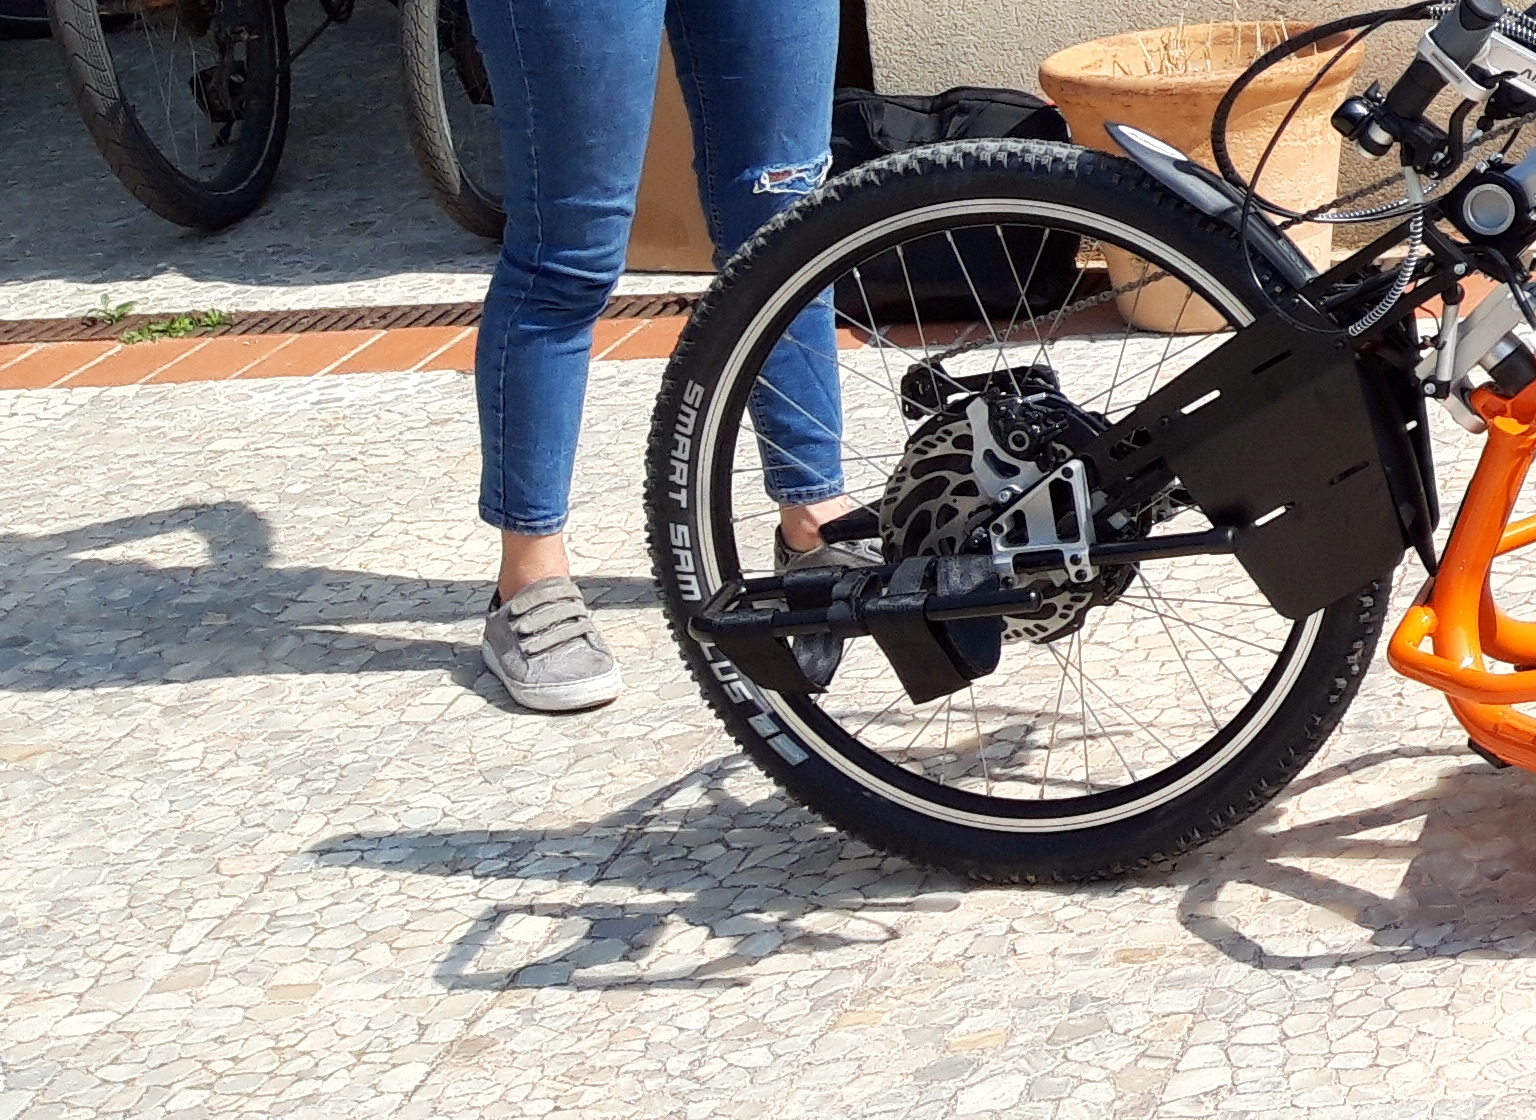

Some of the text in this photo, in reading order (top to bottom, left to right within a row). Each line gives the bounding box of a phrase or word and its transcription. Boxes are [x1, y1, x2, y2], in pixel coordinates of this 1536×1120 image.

[669, 380, 754, 704] SMART SAM LUS
